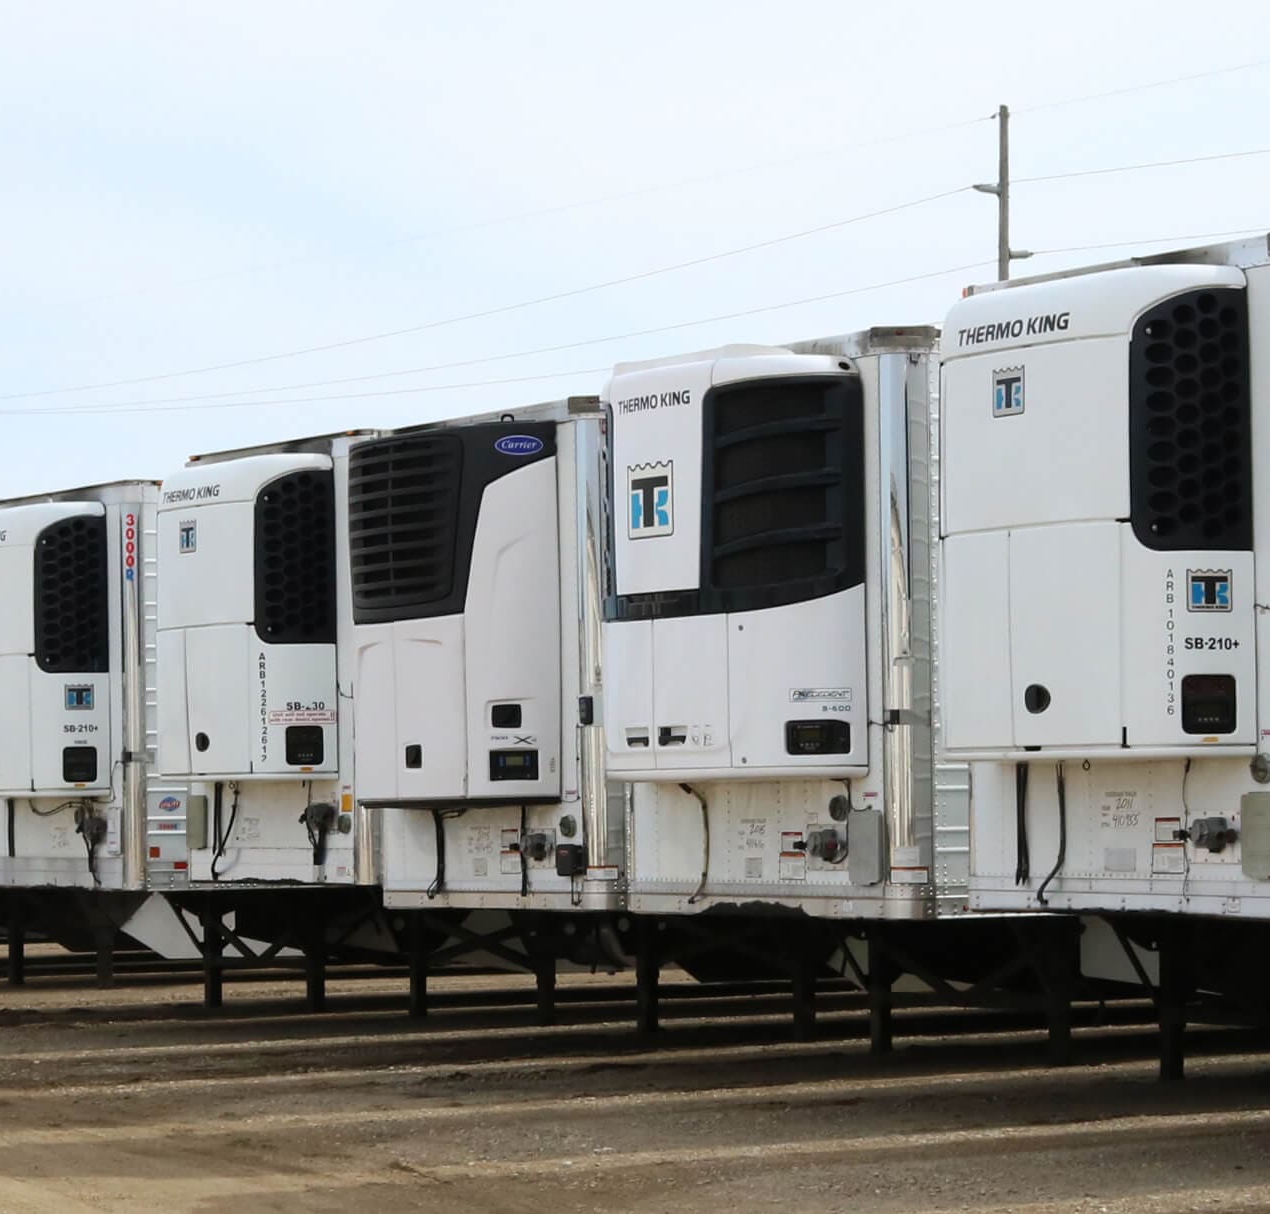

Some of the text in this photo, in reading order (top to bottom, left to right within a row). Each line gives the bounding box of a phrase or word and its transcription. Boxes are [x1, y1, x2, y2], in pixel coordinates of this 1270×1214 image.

[958, 312, 1070, 347] THERMO KING
[618, 390, 691, 416] THERMO KING
[162, 484, 221, 504] THERMO KING
[125, 513, 135, 581] 3000R
